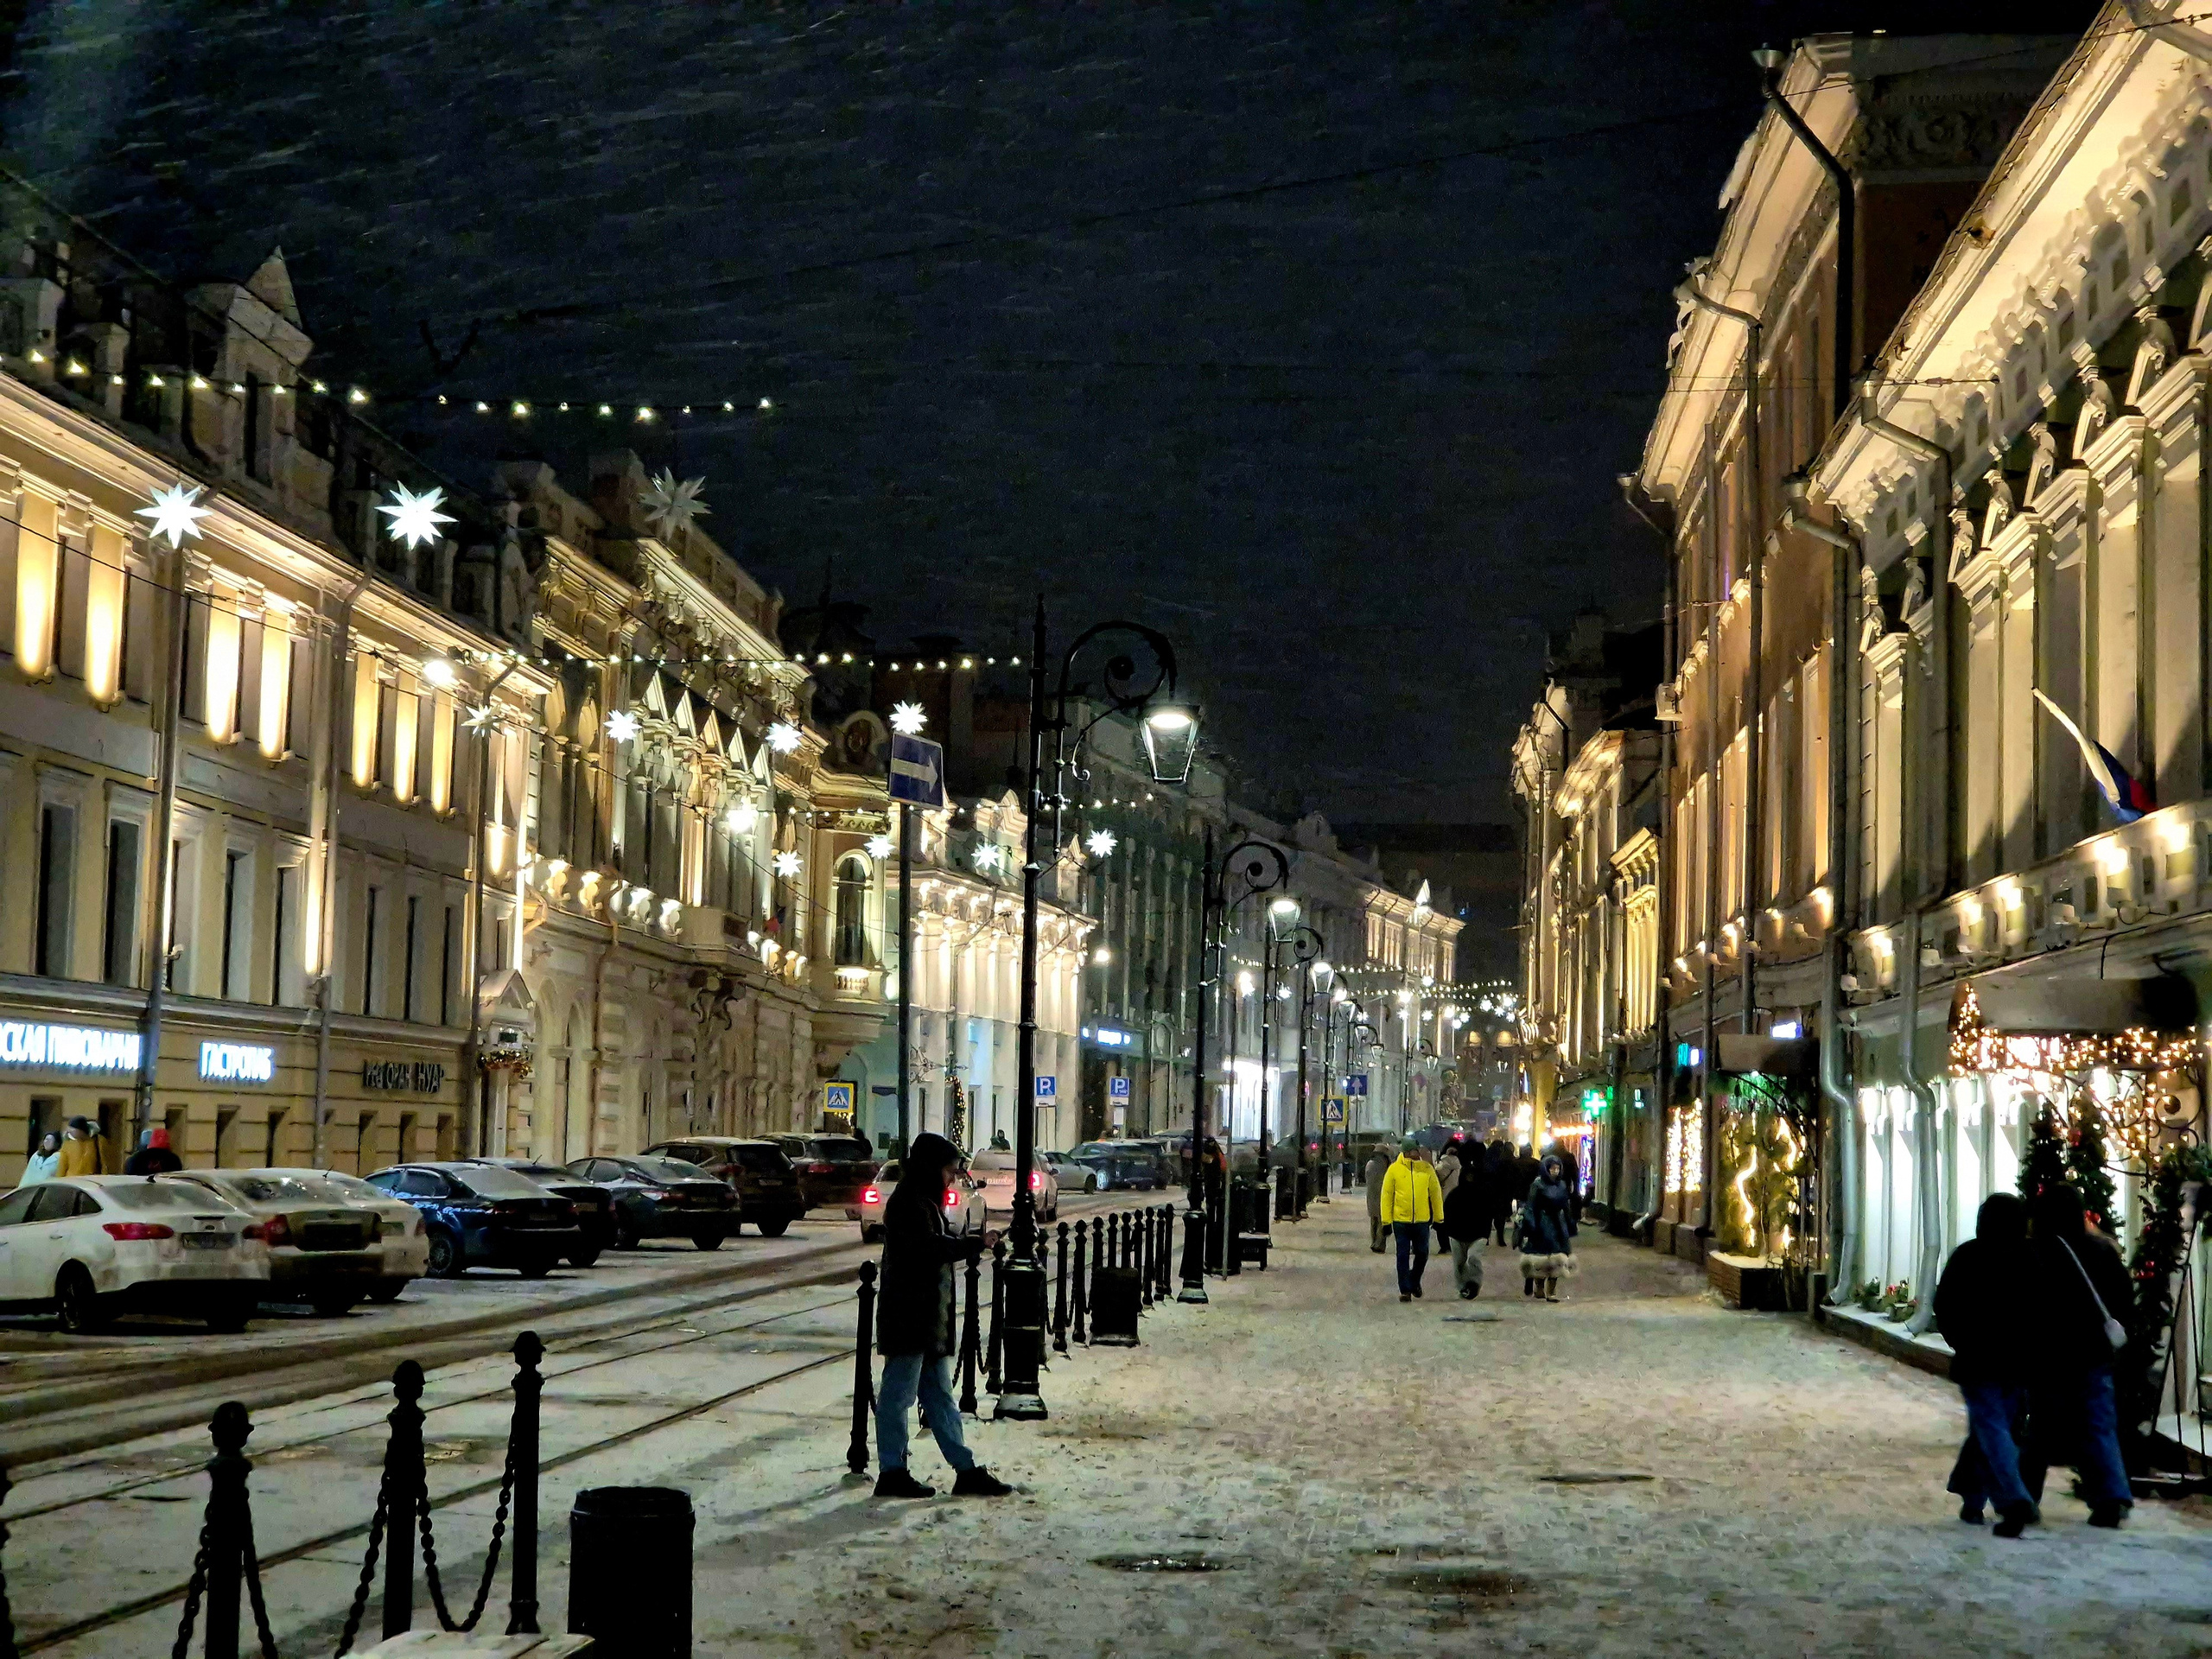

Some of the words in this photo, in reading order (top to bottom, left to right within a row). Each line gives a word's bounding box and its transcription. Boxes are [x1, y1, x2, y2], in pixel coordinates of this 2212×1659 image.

[0, 1022, 46, 1062] СКАЯ
[200, 1042, 273, 1080] ГАСТРОПАБ
[414, 1062, 445, 1093] НУАР
[1115, 1078, 1126, 1094] P
